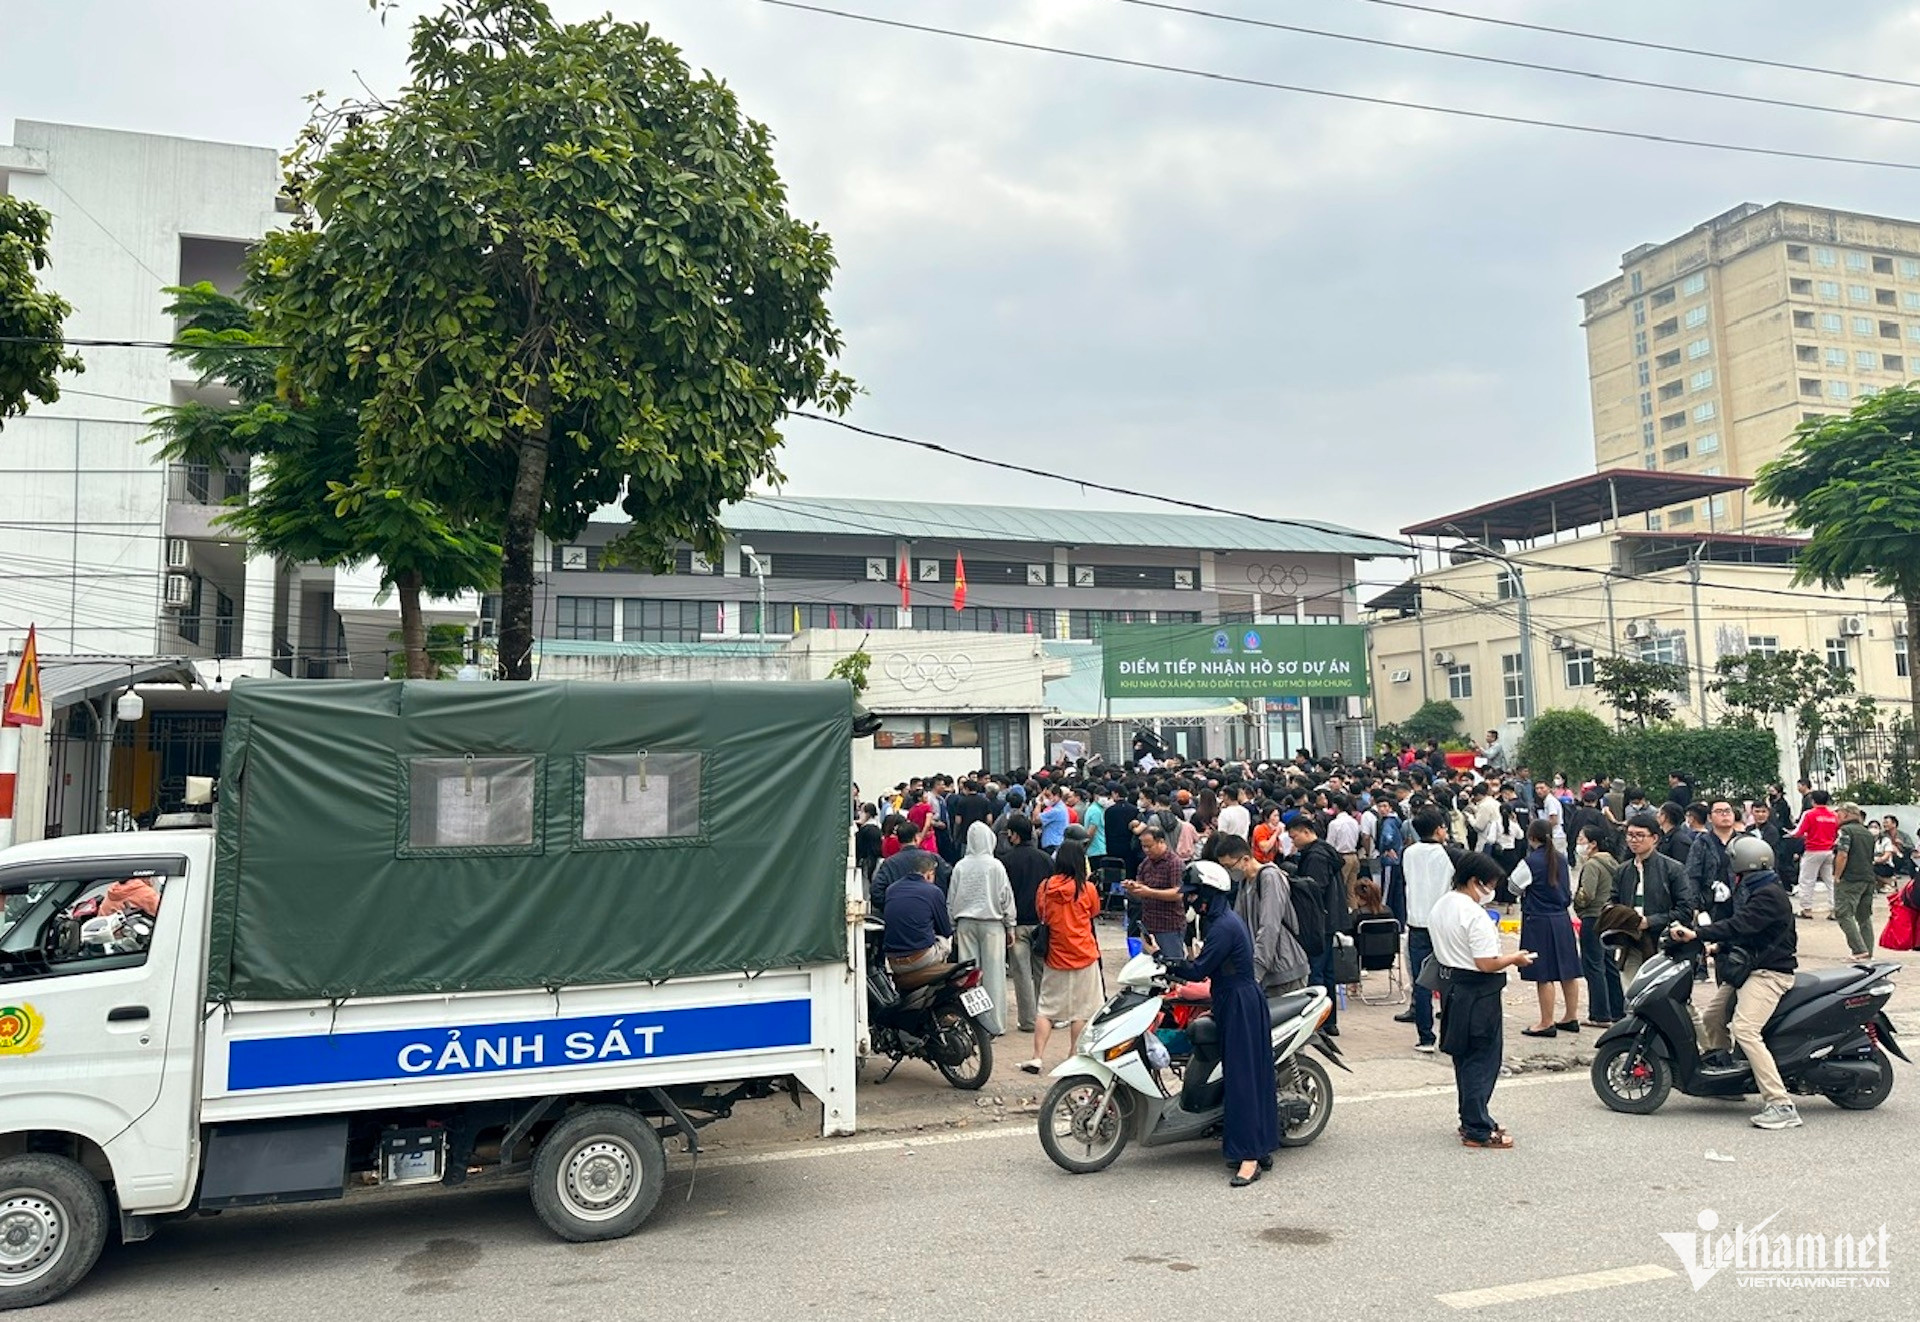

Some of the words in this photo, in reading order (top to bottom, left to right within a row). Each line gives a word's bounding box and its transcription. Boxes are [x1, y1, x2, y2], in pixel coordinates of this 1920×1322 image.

[1119, 656, 1160, 674] ĐIỂM
[1163, 657, 1197, 674] TIẾP
[1201, 658, 1245, 677] NHẬN
[1250, 657, 1273, 674] HỒ
[1277, 660, 1298, 674] SƠ
[1302, 660, 1326, 676] DỰ
[1329, 657, 1350, 674] ÁN
[1120, 680, 1138, 688] KHU
[1140, 678, 1158, 688] NHÀ
[1252, 680, 1268, 688] CT4
[1307, 679, 1322, 688] KIM
[1323, 678, 1352, 688] CHUNG
[397, 1029, 545, 1073] CẢNH
[564, 1018, 665, 1063] SÁT
